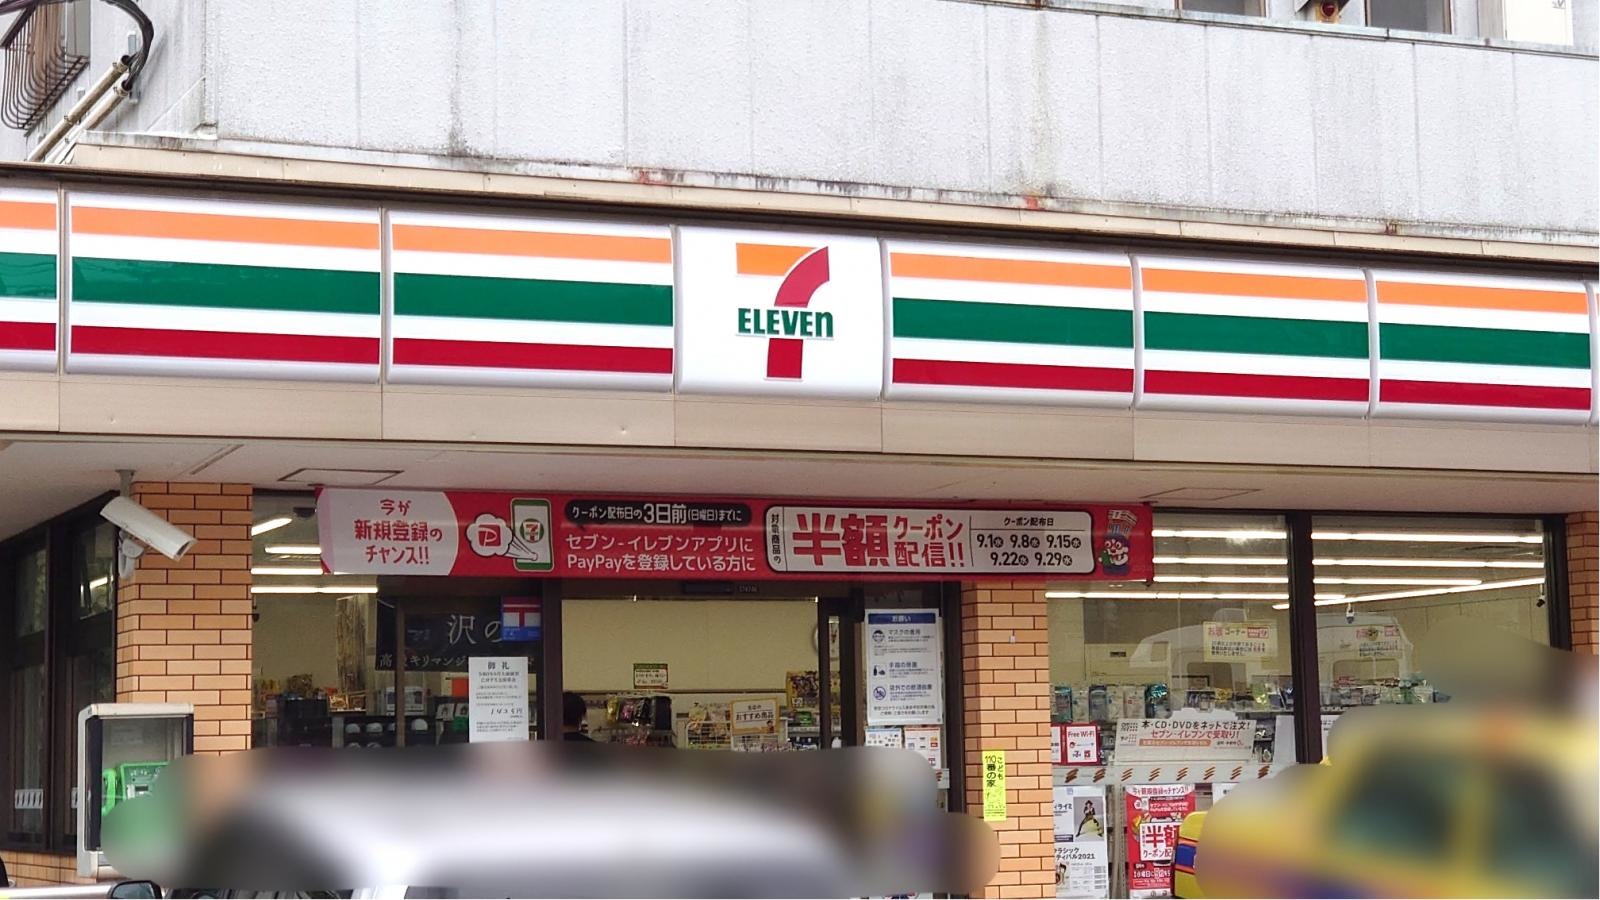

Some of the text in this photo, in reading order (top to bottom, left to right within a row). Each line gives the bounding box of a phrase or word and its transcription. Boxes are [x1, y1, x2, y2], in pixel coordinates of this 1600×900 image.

[736, 242, 830, 379] 7
[380, 499, 411, 516] 今が
[354, 519, 443, 542] 新規登録の
[894, 514, 964, 541] クーポン
[1003, 517, 1055, 527] クーポン配布日
[792, 513, 890, 567] 半額
[567, 554, 756, 573] PayPayを登録している方に
